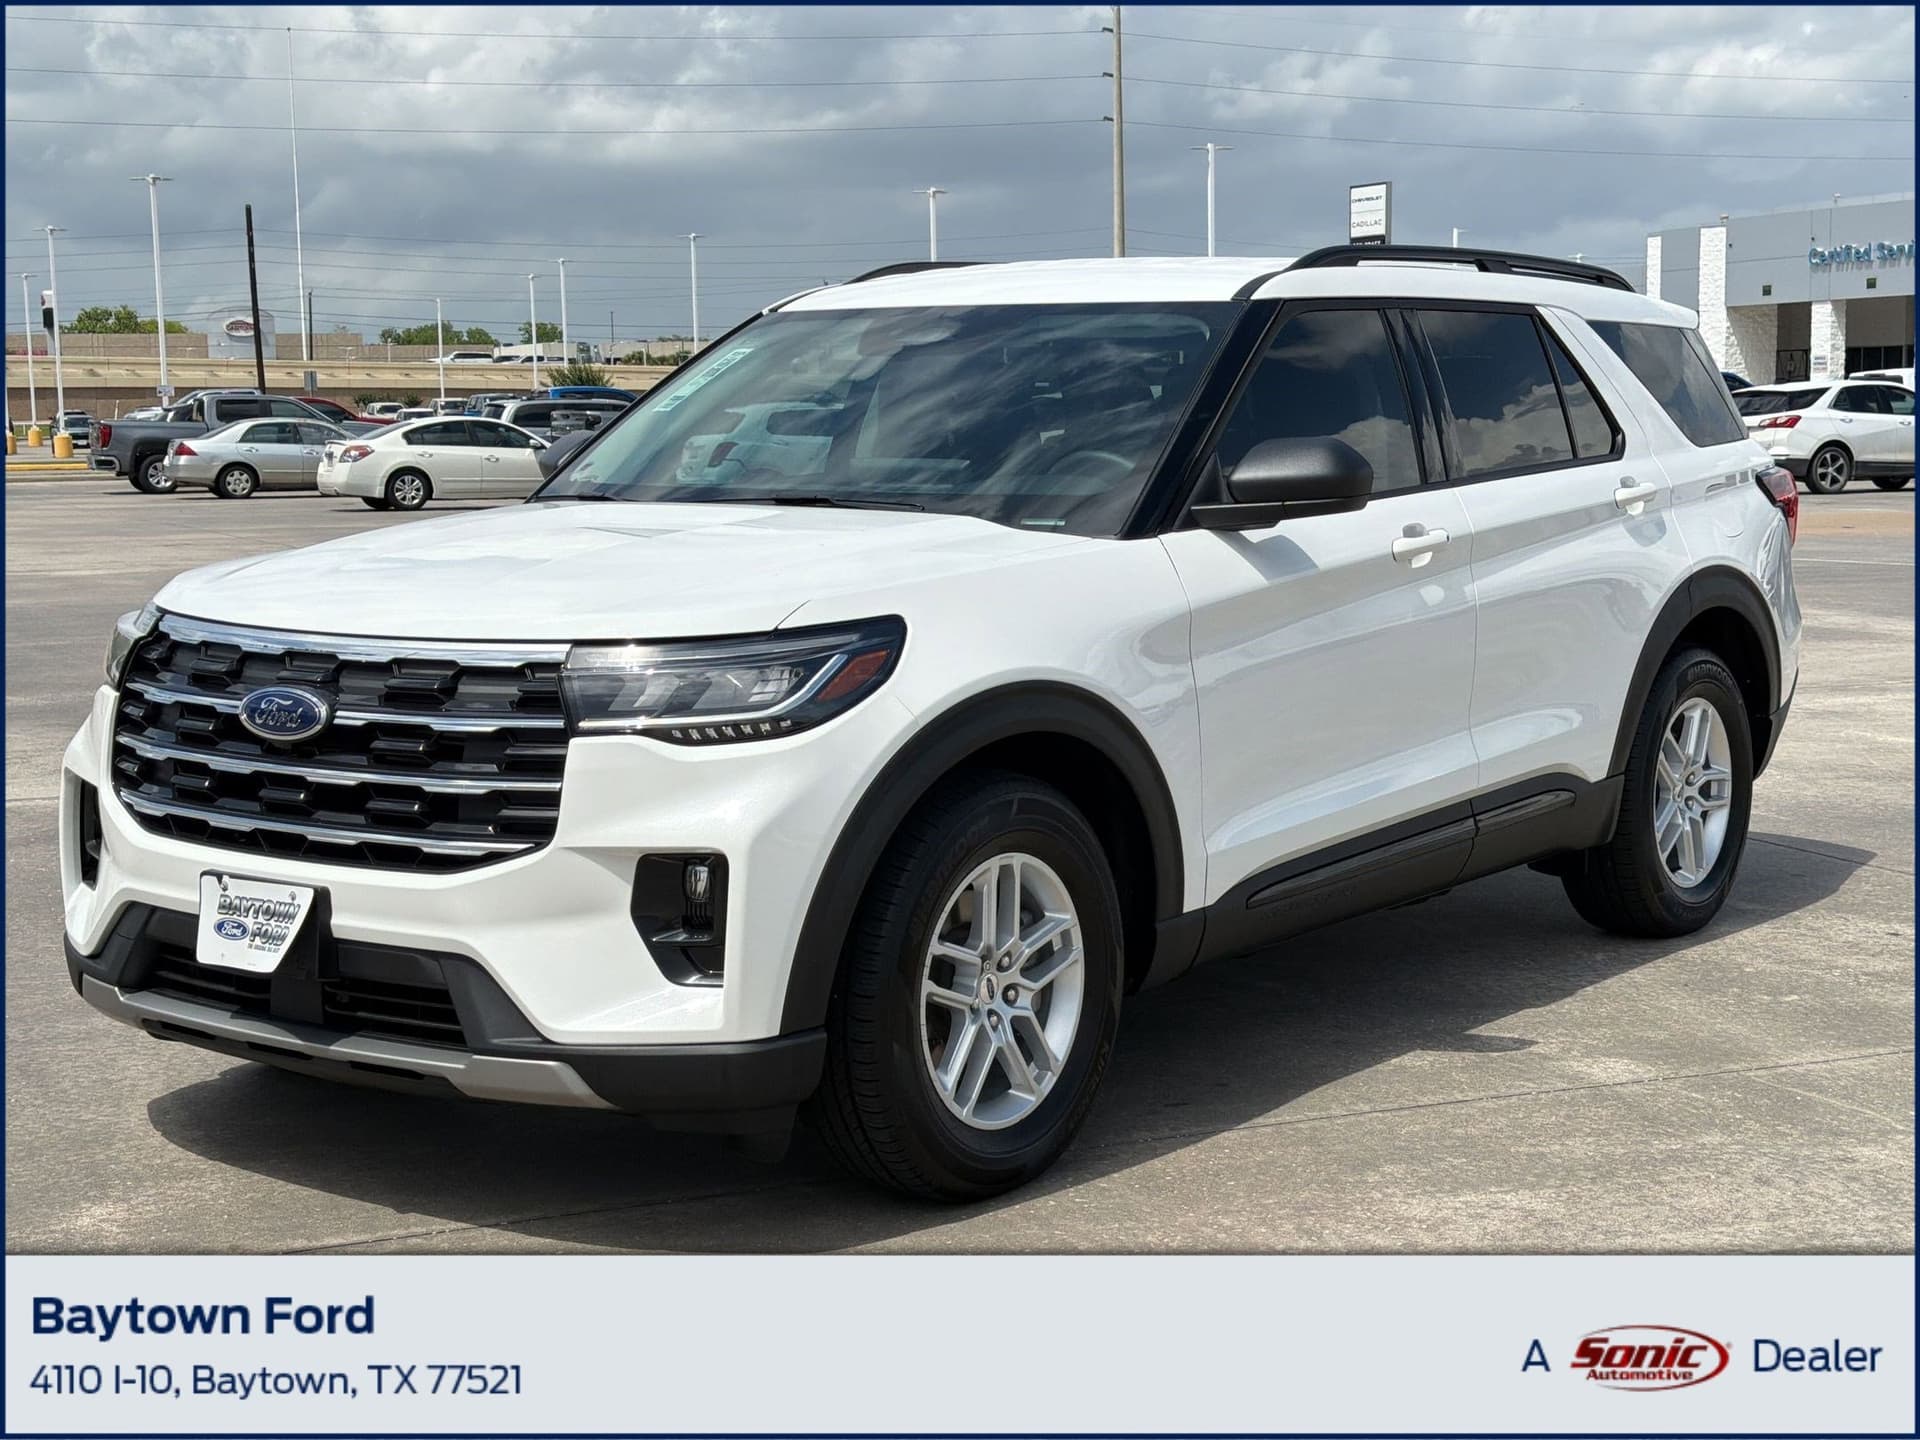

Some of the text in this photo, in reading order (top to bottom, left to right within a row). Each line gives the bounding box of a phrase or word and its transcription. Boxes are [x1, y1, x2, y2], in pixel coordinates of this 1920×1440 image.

[1352, 218, 1383, 228] CADILLAC
[1808, 242, 1872, 265] Certified
[255, 696, 303, 728] Ford
[217, 894, 301, 924] BAYTOWN
[221, 920, 244, 936] Ford
[249, 921, 290, 946] FORD
